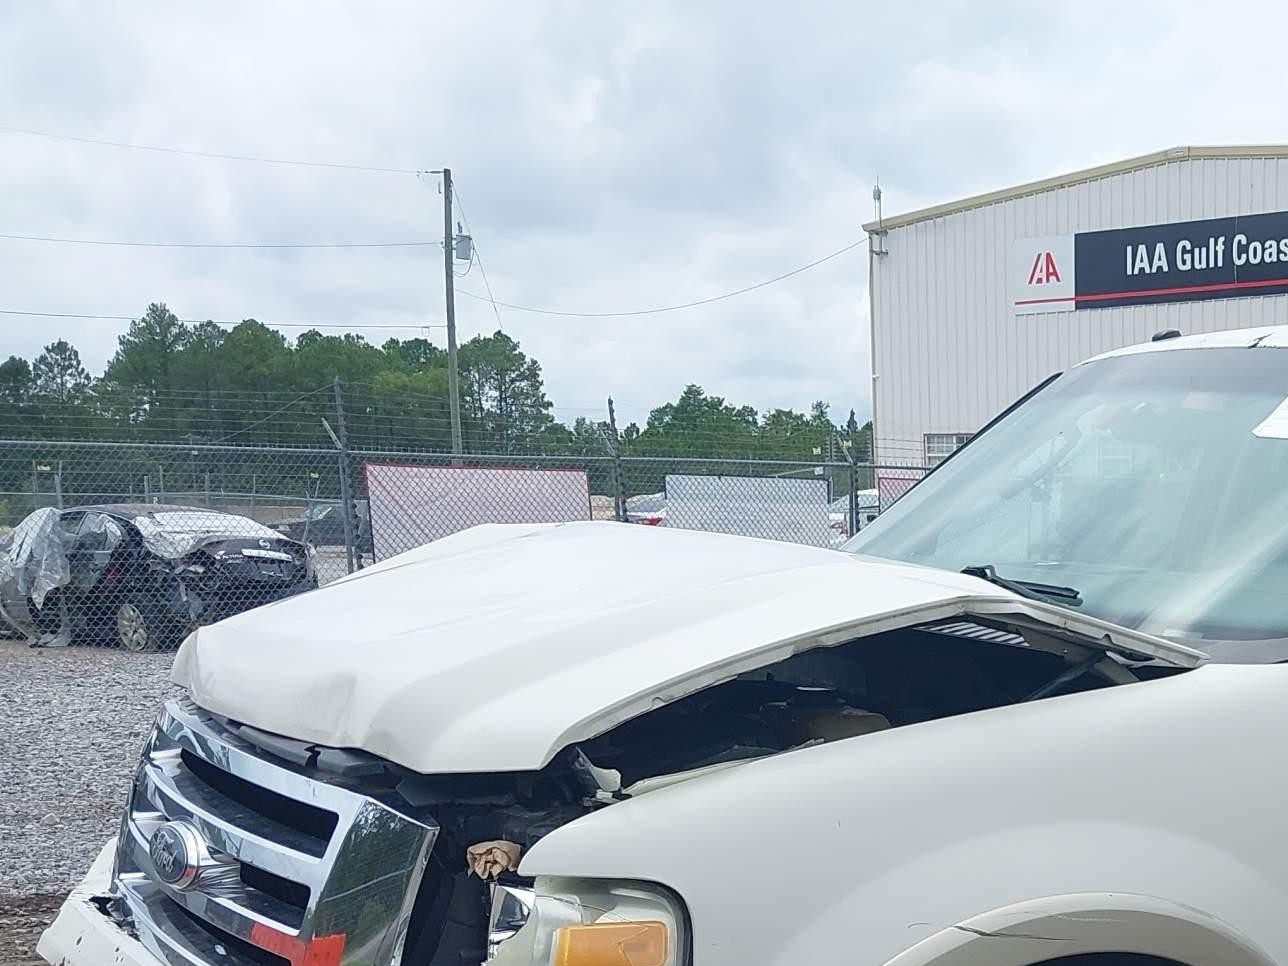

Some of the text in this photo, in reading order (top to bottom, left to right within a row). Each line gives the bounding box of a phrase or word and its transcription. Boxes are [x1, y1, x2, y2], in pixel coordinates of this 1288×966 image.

[1126, 242, 1169, 276] IAA
[1176, 235, 1225, 271] Gulf
[151, 831, 177, 873] Ford
